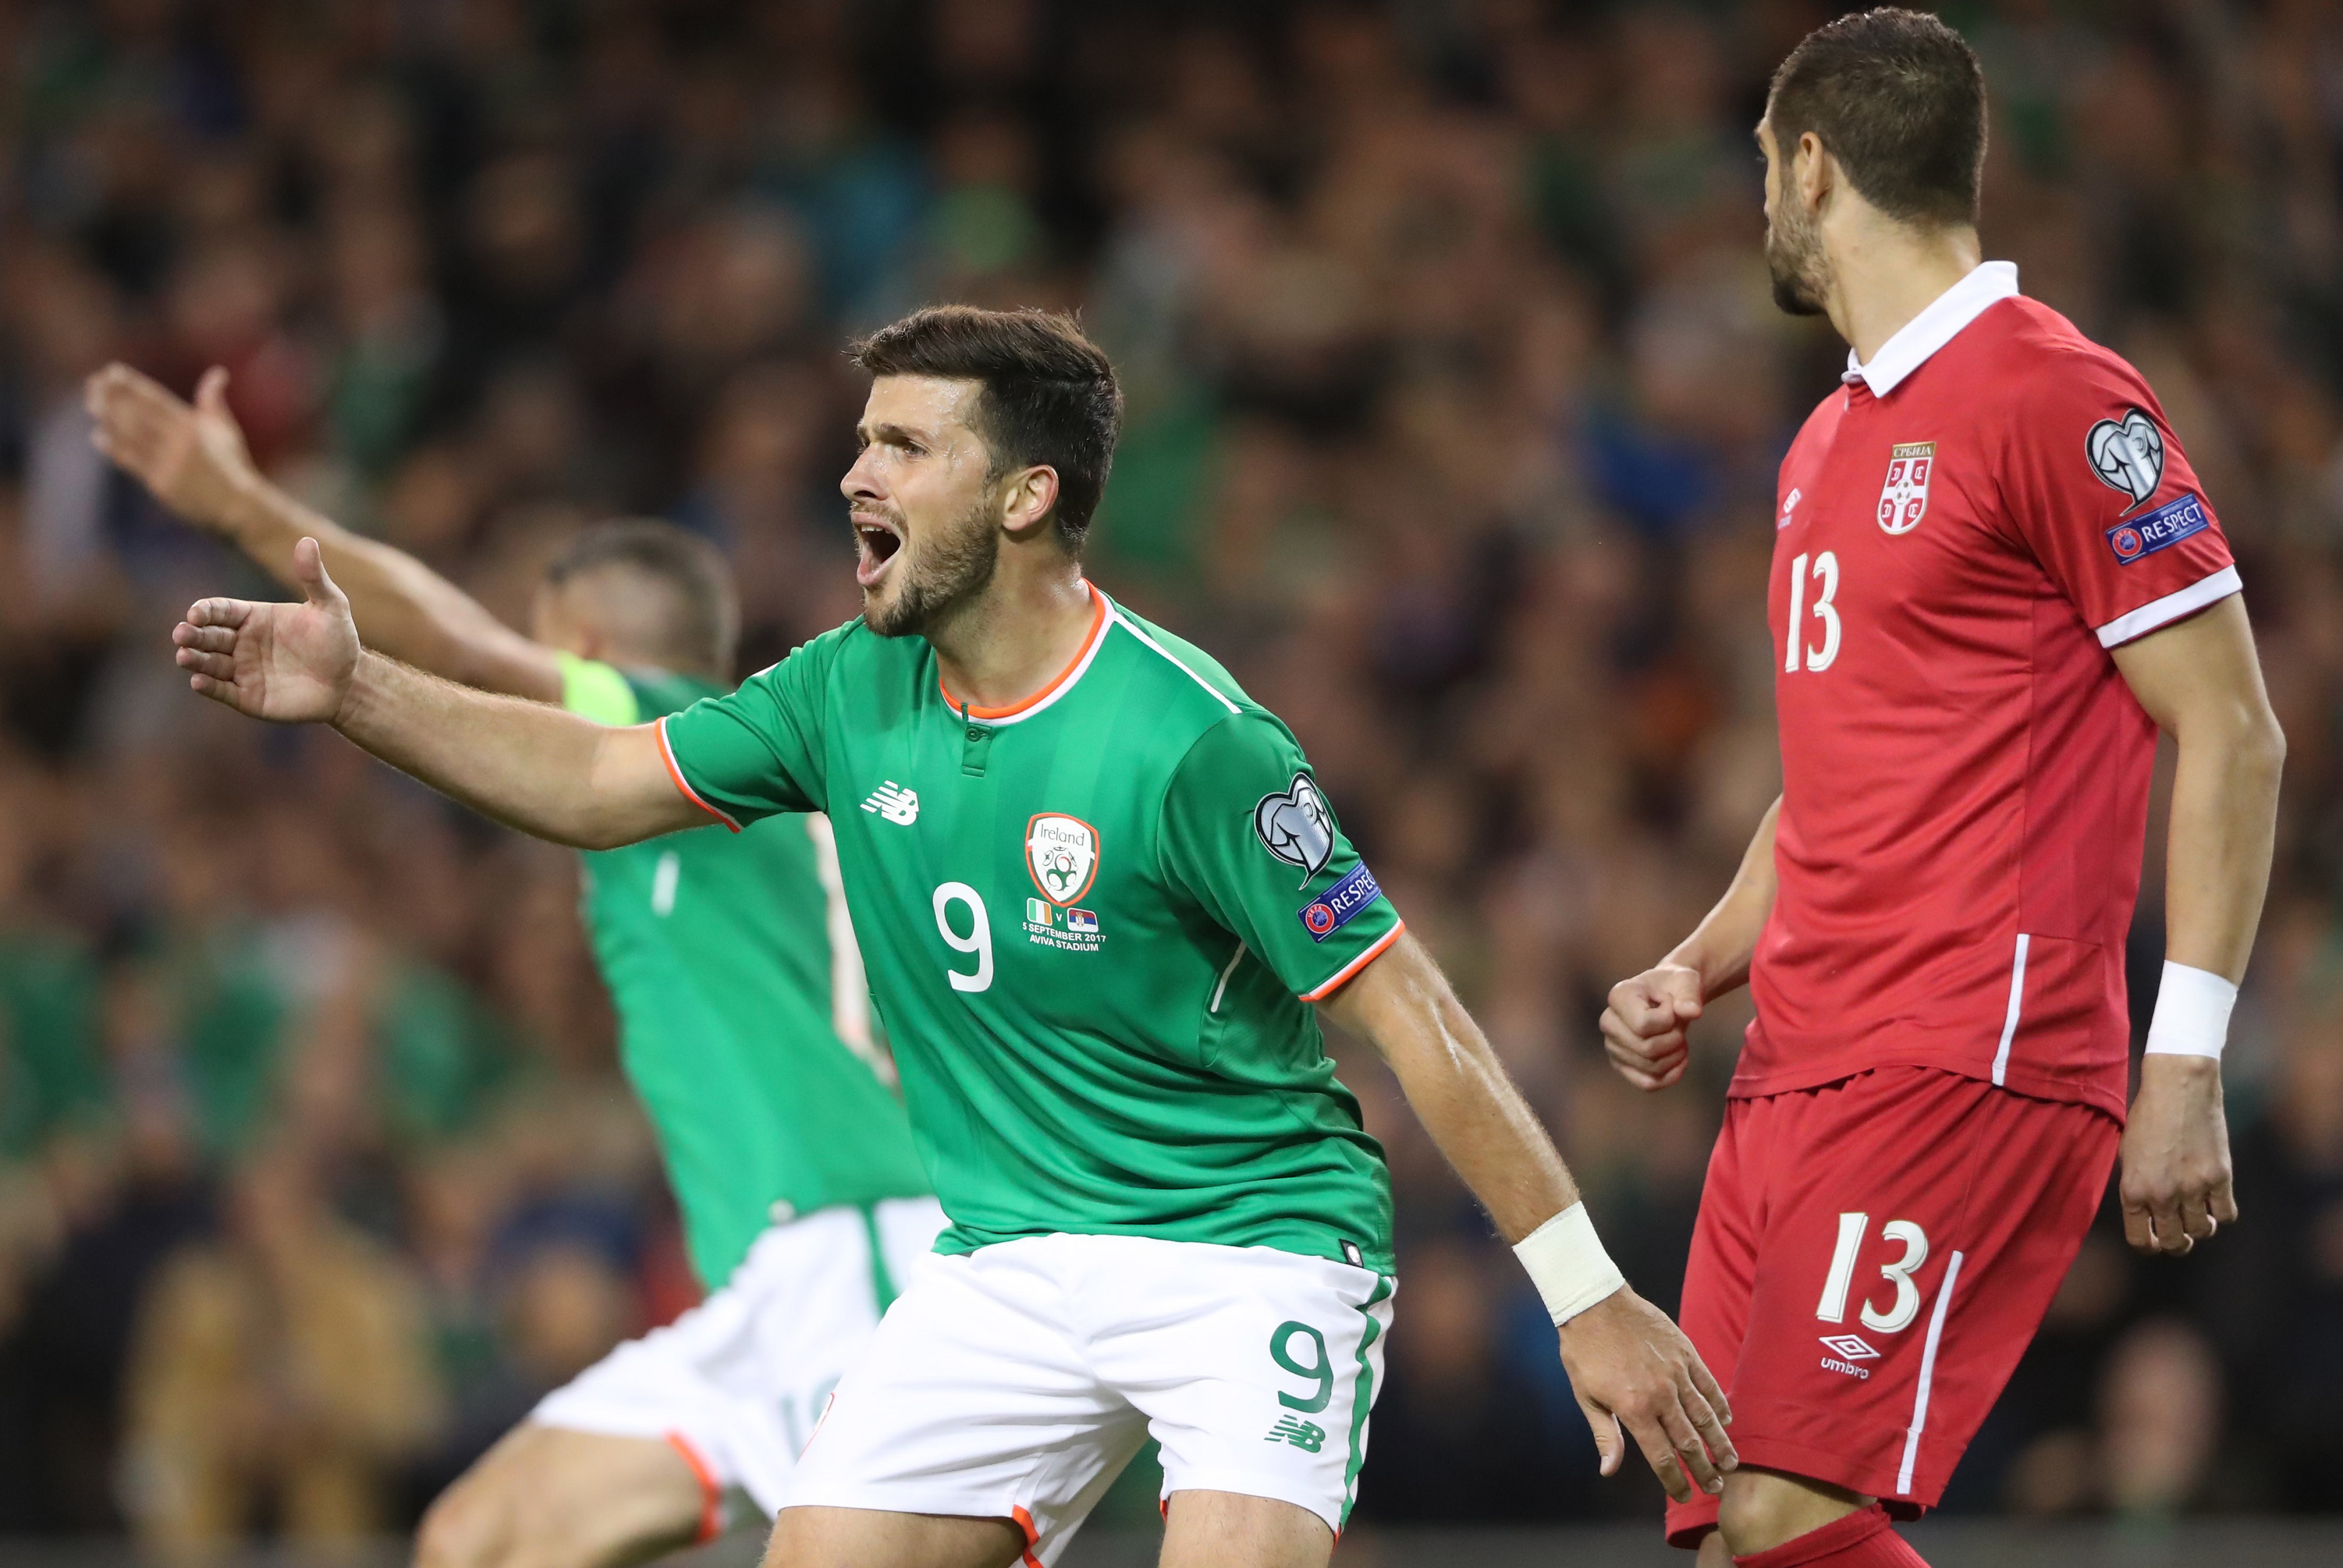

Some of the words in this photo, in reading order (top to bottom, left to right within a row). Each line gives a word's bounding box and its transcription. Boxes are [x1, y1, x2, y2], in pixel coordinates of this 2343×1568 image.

[1894, 446, 1931, 457] СРБИЈА
[2141, 503, 2201, 542] RESPECT
[2115, 530, 2132, 540] UEFA
[1785, 550, 1841, 672] 13
[1040, 824, 1084, 846] Ireland
[1308, 906, 1322, 918] UEFA
[932, 882, 994, 993] 9
[1022, 921, 1027, 930] 5
[1029, 923, 1082, 941] SEPTEMBER
[1084, 934, 1106, 942] 2017
[1029, 934, 1055, 946] AVIVA
[1055, 939, 1099, 951] STADIUM
[1816, 1211, 1929, 1333] 13
[1269, 1320, 1334, 1414] 9
[1821, 1357, 1869, 1380] umbro
